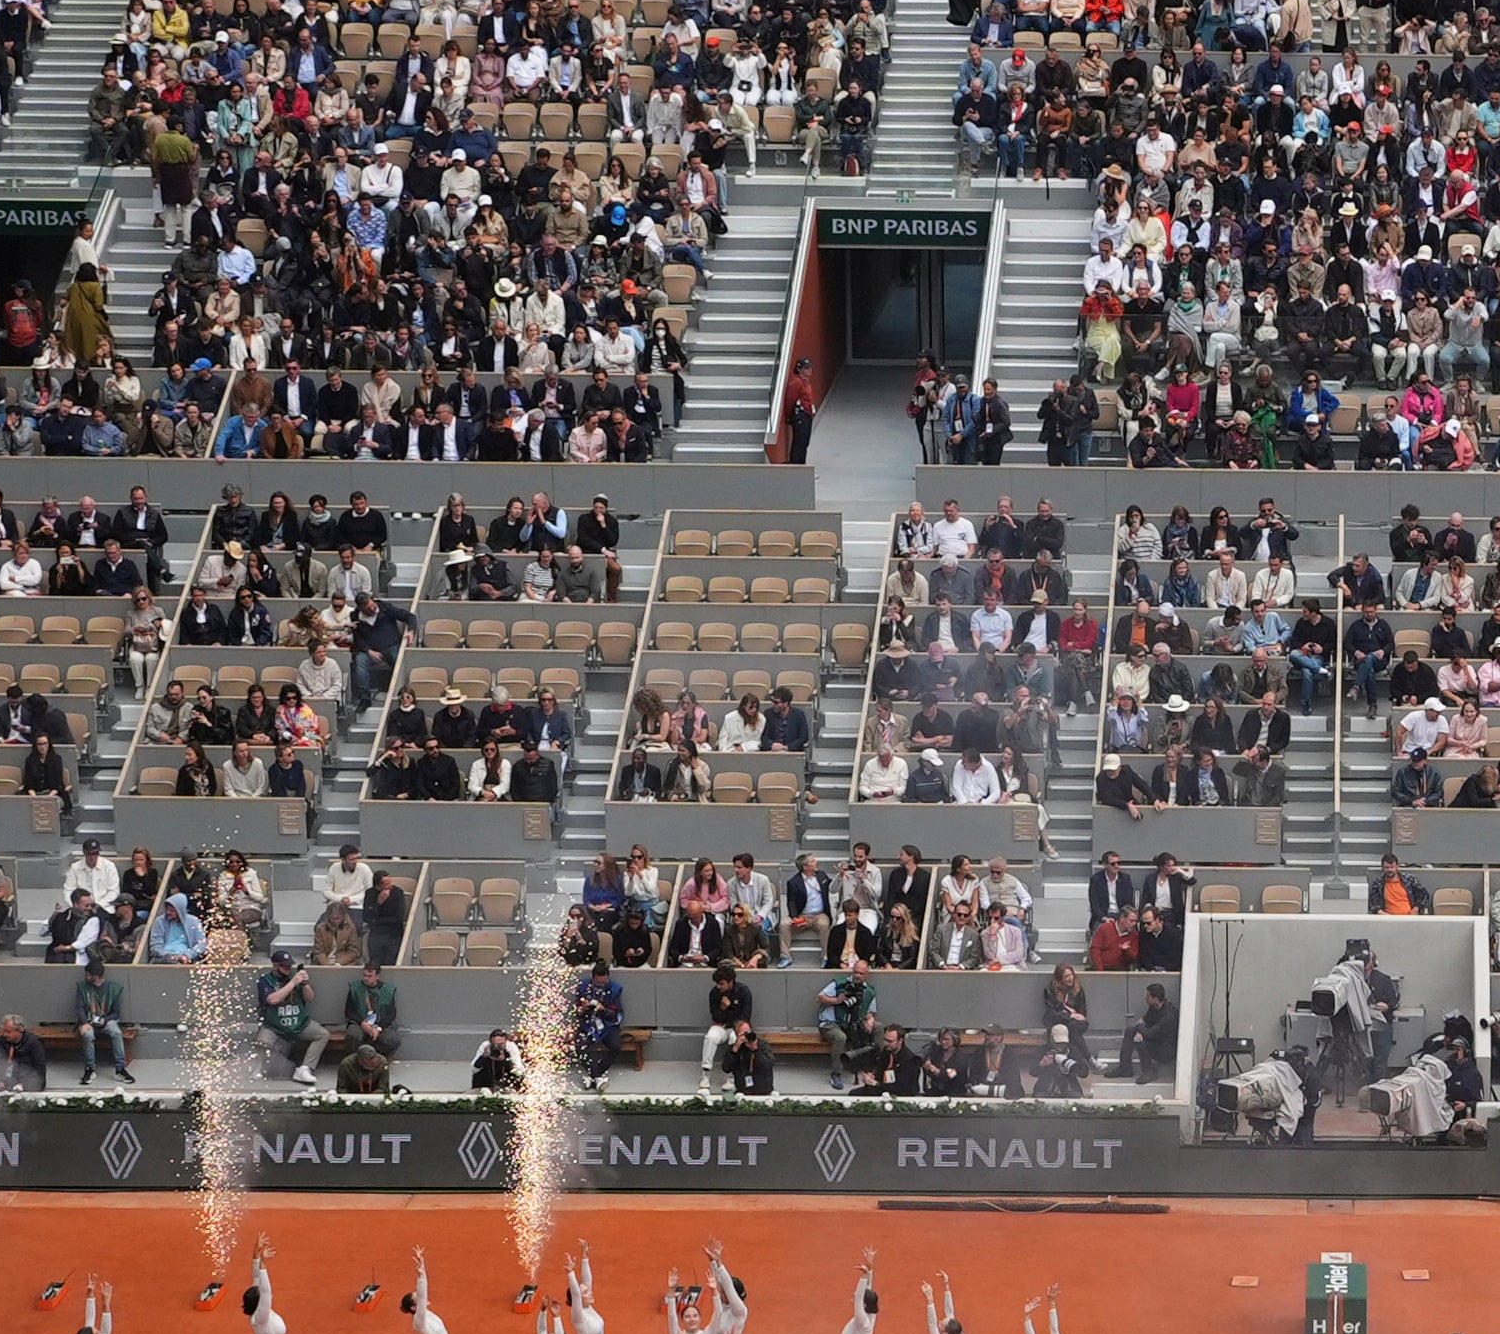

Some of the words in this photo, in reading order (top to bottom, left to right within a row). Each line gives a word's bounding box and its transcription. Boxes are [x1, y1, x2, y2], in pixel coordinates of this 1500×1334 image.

[831, 217, 878, 235] BNP
[883, 218, 978, 237] PARIBAS
[546, 1135, 768, 1167] ENAULT
[898, 1137, 1123, 1170] RENAULT
[1312, 1318, 1361, 1334] Her
